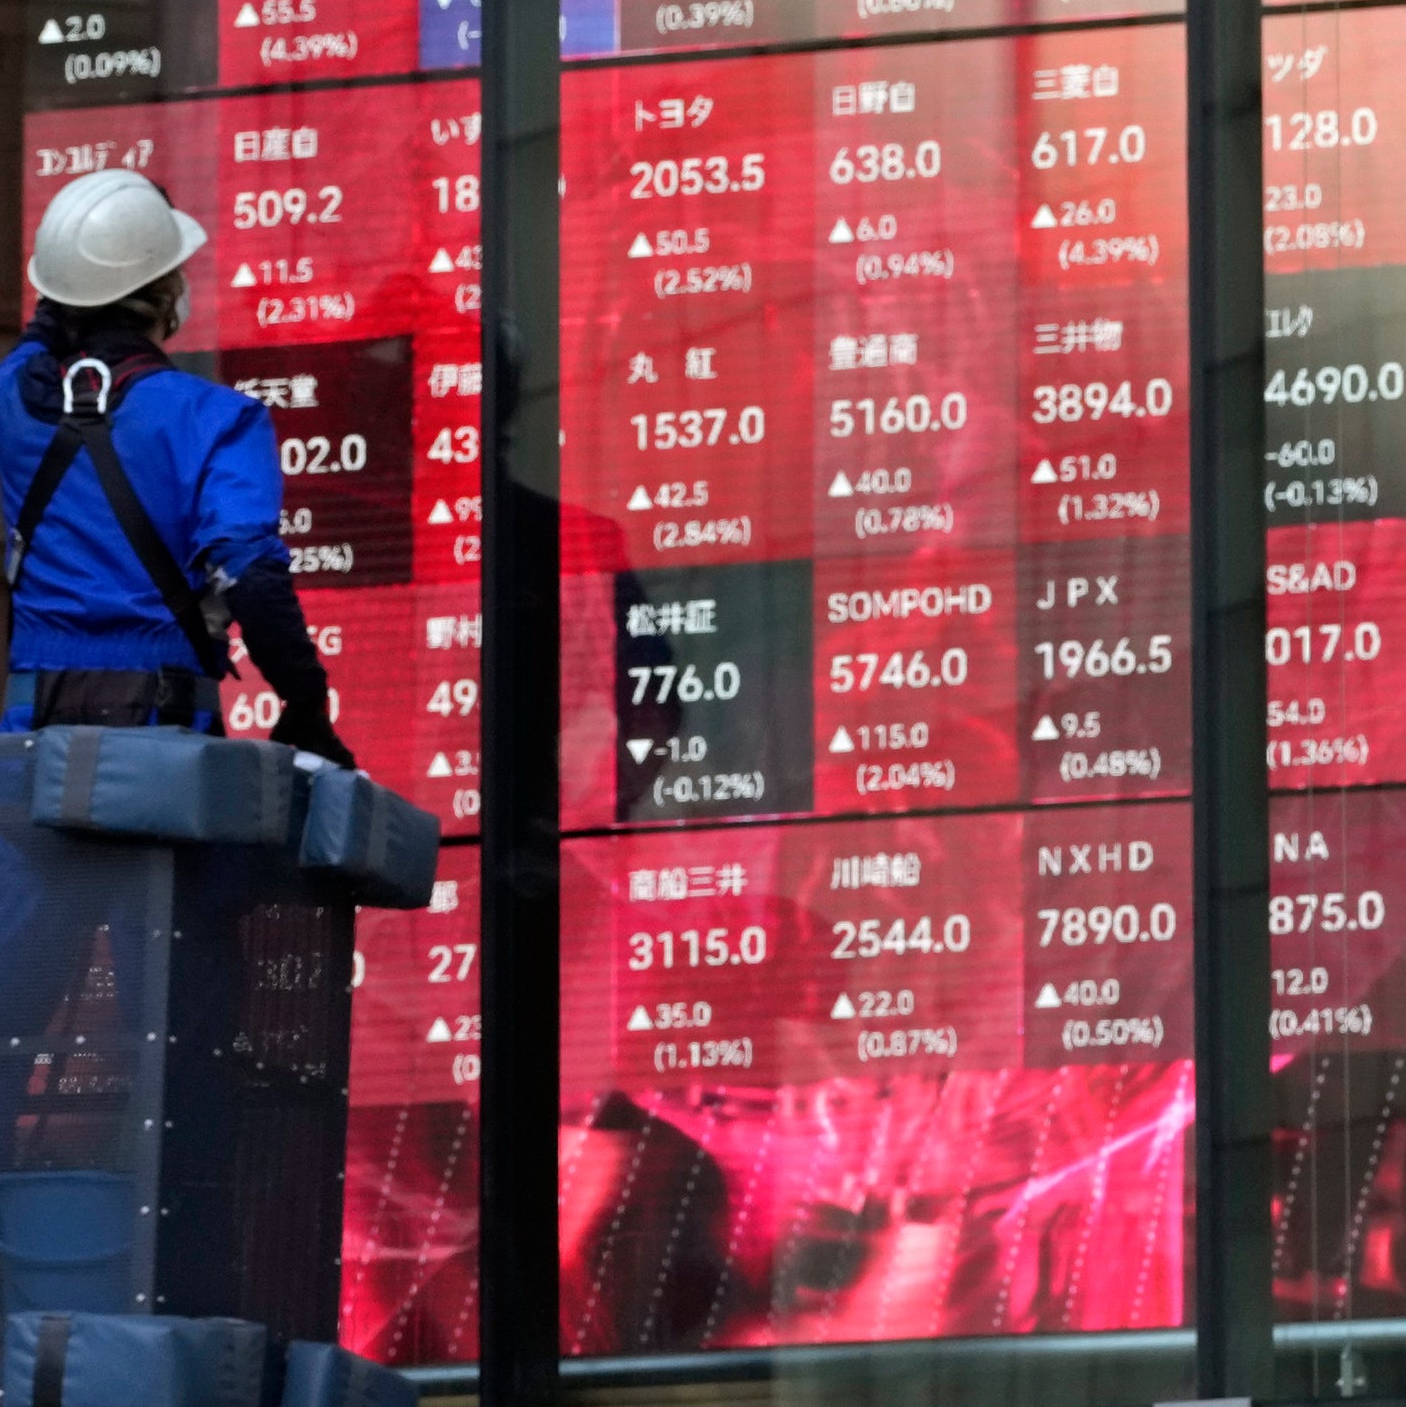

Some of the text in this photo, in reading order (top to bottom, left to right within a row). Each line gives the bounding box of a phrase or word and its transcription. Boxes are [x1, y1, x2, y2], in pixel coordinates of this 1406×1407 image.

[259, 33, 358, 65] (4.39%)
[833, 81, 915, 115] 日野自
[1035, 64, 1119, 99] 三菱自
[635, 95, 714, 129] トヨタ
[234, 127, 318, 162] 日産自
[829, 140, 941, 184] 638.0
[1032, 124, 1146, 169] 617.0
[630, 153, 765, 199] 2053.5
[234, 185, 343, 229] 509.2
[1060, 198, 1116, 227] 26.0
[655, 227, 710, 256] 50.5
[1058, 234, 1159, 270] (4.39%)
[259, 256, 314, 283] 11.5
[654, 263, 752, 297] (2.52%)
[256, 293, 355, 326] (2.31%)
[1035, 319, 1124, 354] 三井物
[830, 392, 967, 437] 5160.0
[1033, 378, 1173, 424] 3894.0
[631, 406, 765, 450] 1537.0
[1059, 453, 1117, 482] 51.0
[654, 481, 709, 508] 42.5
[1057, 490, 1160, 524] (1.32%)
[828, 583, 992, 623] SOMPOHD
[1037, 575, 1118, 610] JPX
[626, 599, 716, 636] 松井証
[830, 648, 968, 693] 5746.0
[1035, 634, 1172, 679] 1966.5
[628, 661, 741, 705] 776.0
[858, 721, 929, 749] 115.0
[653, 771, 765, 806] (-0.12%)
[1038, 841, 1154, 876] NXHD
[832, 914, 970, 959] 2544.0
[1038, 903, 1176, 947] 7890.0
[629, 925, 766, 971] 3115.0
[1272, 967, 1329, 996] 12.0
[1061, 1016, 1164, 1050] (0.50%)
[1269, 1004, 1373, 1039] (0.41%)
[654, 1037, 753, 1072] (1.13%)
